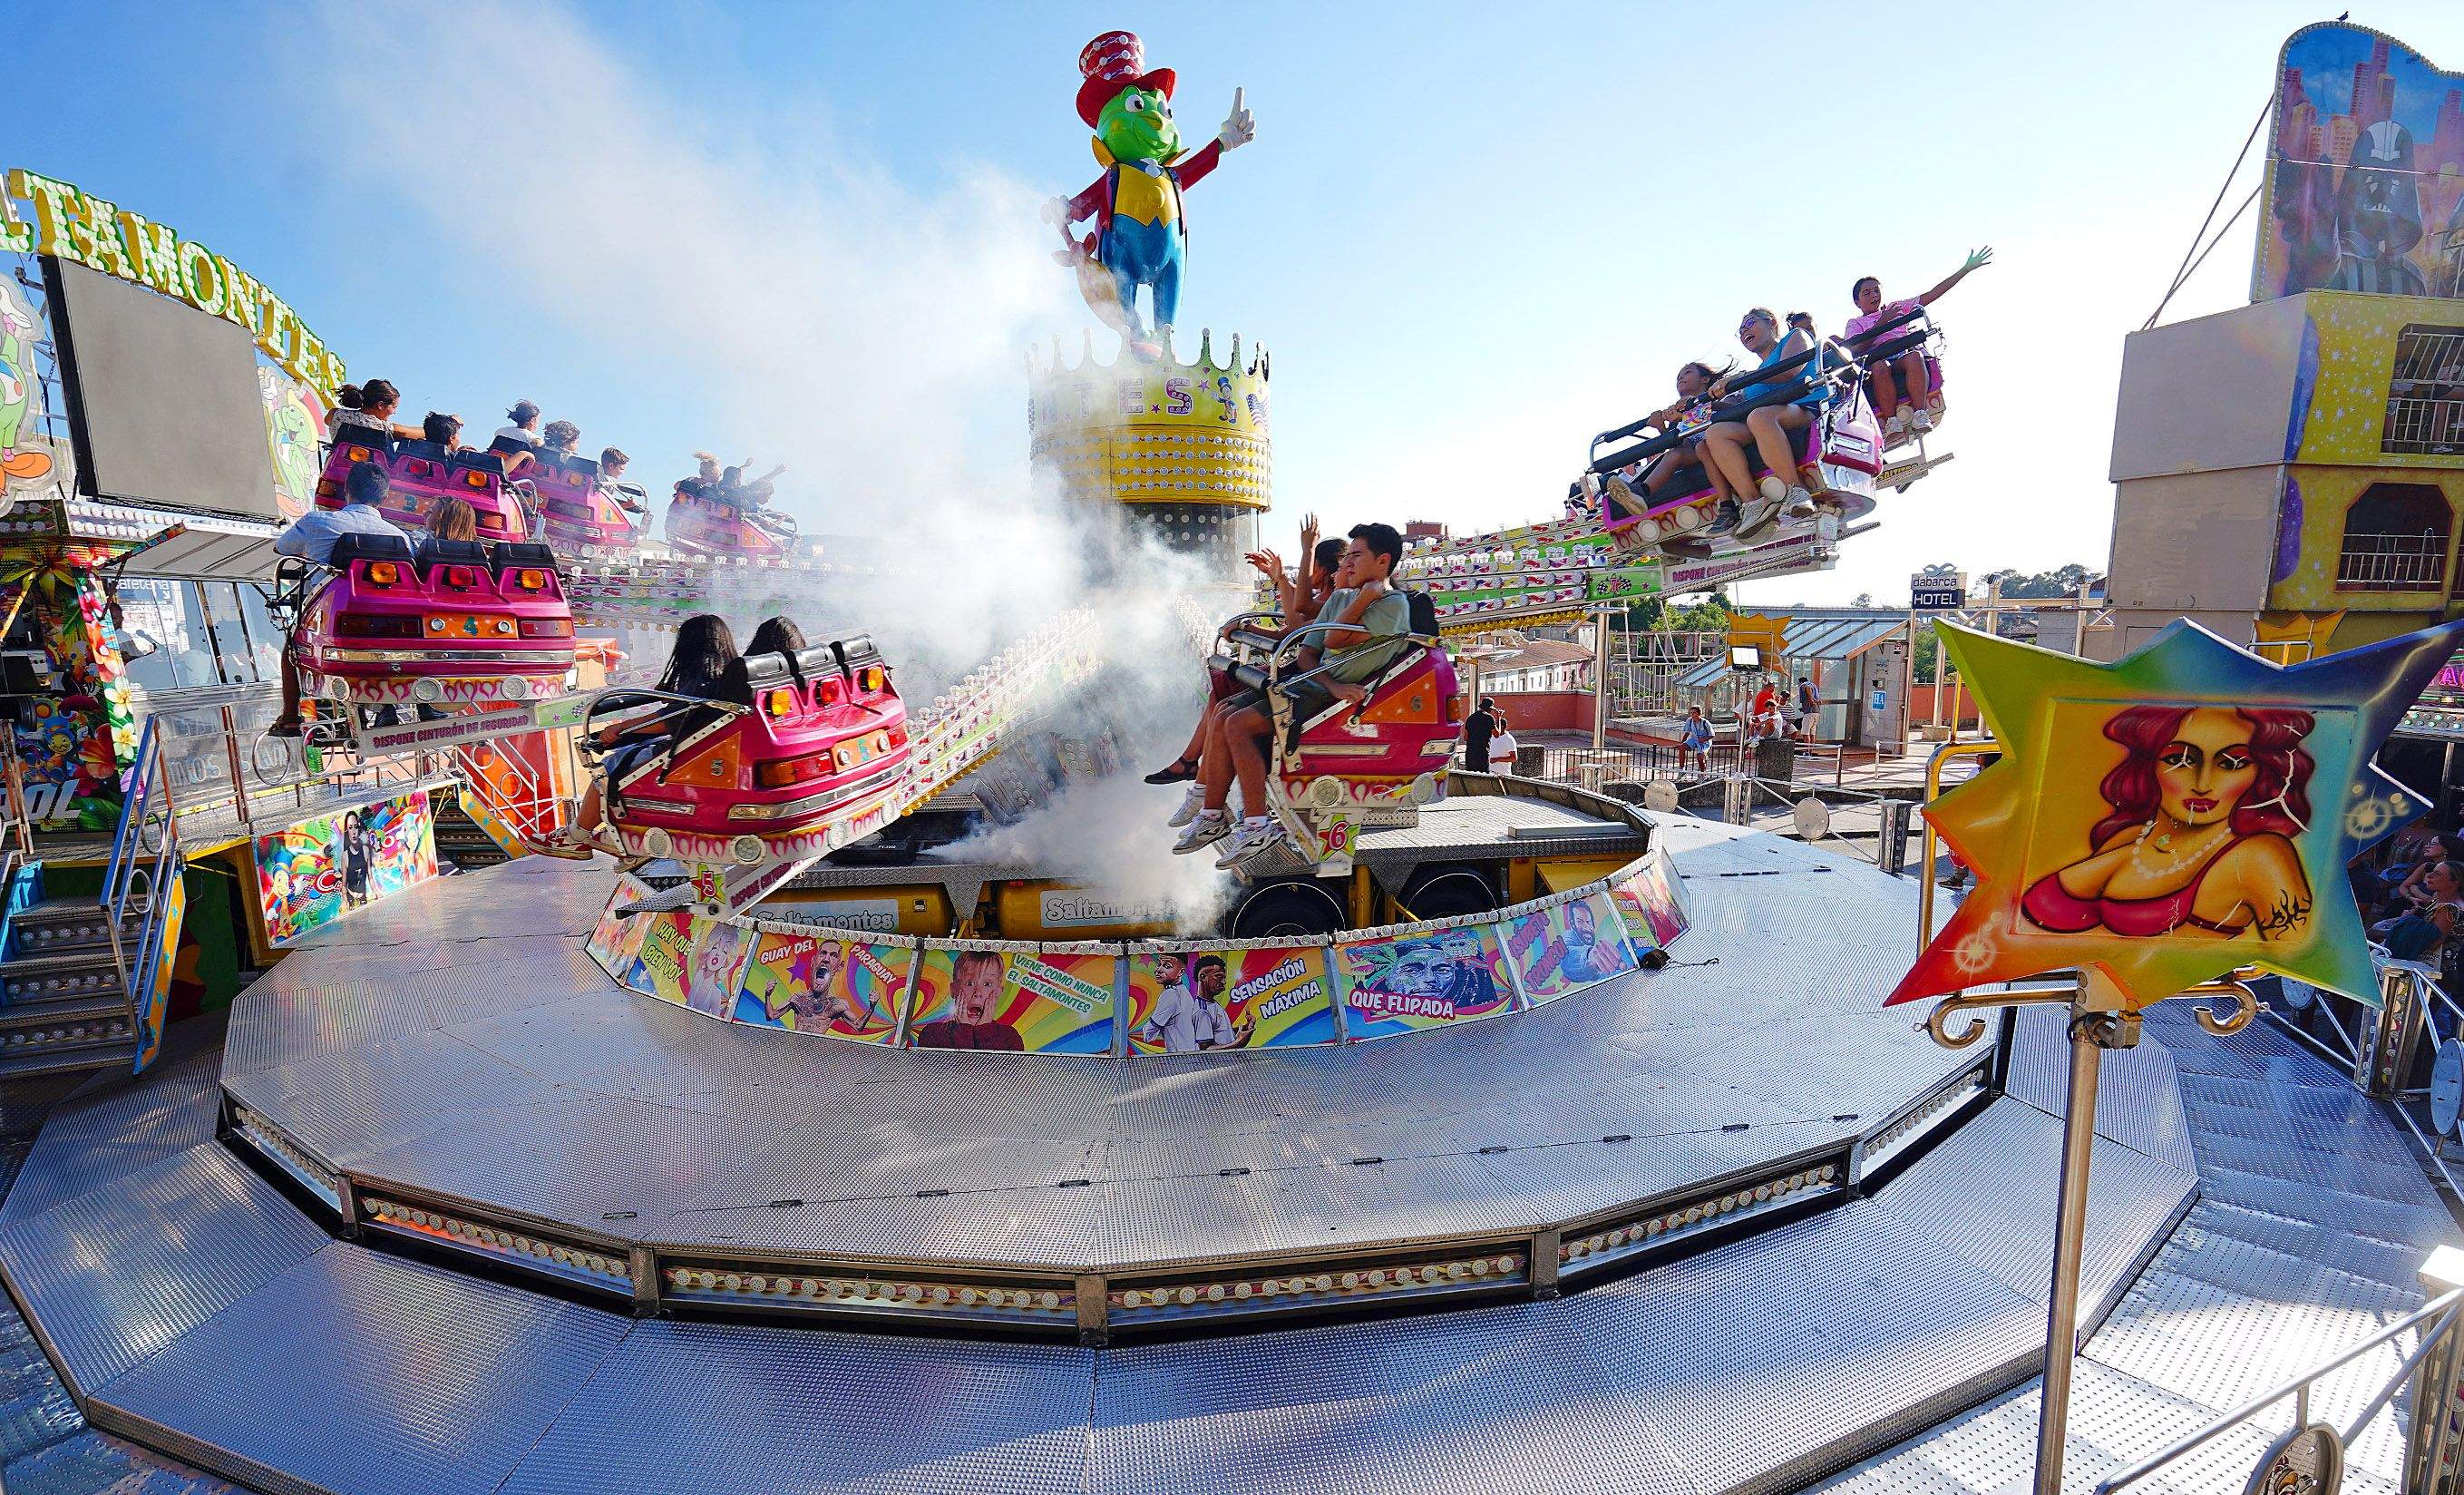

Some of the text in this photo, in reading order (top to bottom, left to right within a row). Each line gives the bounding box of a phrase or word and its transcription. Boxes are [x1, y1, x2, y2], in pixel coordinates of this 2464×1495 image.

[1914, 577, 1957, 587] dabarca
[1914, 594, 1957, 605] HOTEL
[463, 617, 479, 636] 4
[373, 715, 529, 748] DISPONE CINTURÓN DE SEGURIDAD
[711, 758, 725, 776] 5
[1329, 821, 1349, 850] 6
[702, 871, 716, 897] 5
[657, 921, 695, 956] HAY QUE
[760, 940, 814, 963] GUAY DEL
[644, 944, 685, 982] BIEN VOY
[851, 944, 898, 984] PARAGUAY
[1016, 954, 1108, 1002] VIENE COMO NUNCA
[1008, 971, 1091, 1013] EL SALTAMONTES
[1230, 958, 1306, 1003] SENSACIÓN
[1260, 981, 1321, 1020] MÁXIMA
[1351, 991, 1455, 1018] QUE FLIPADA
